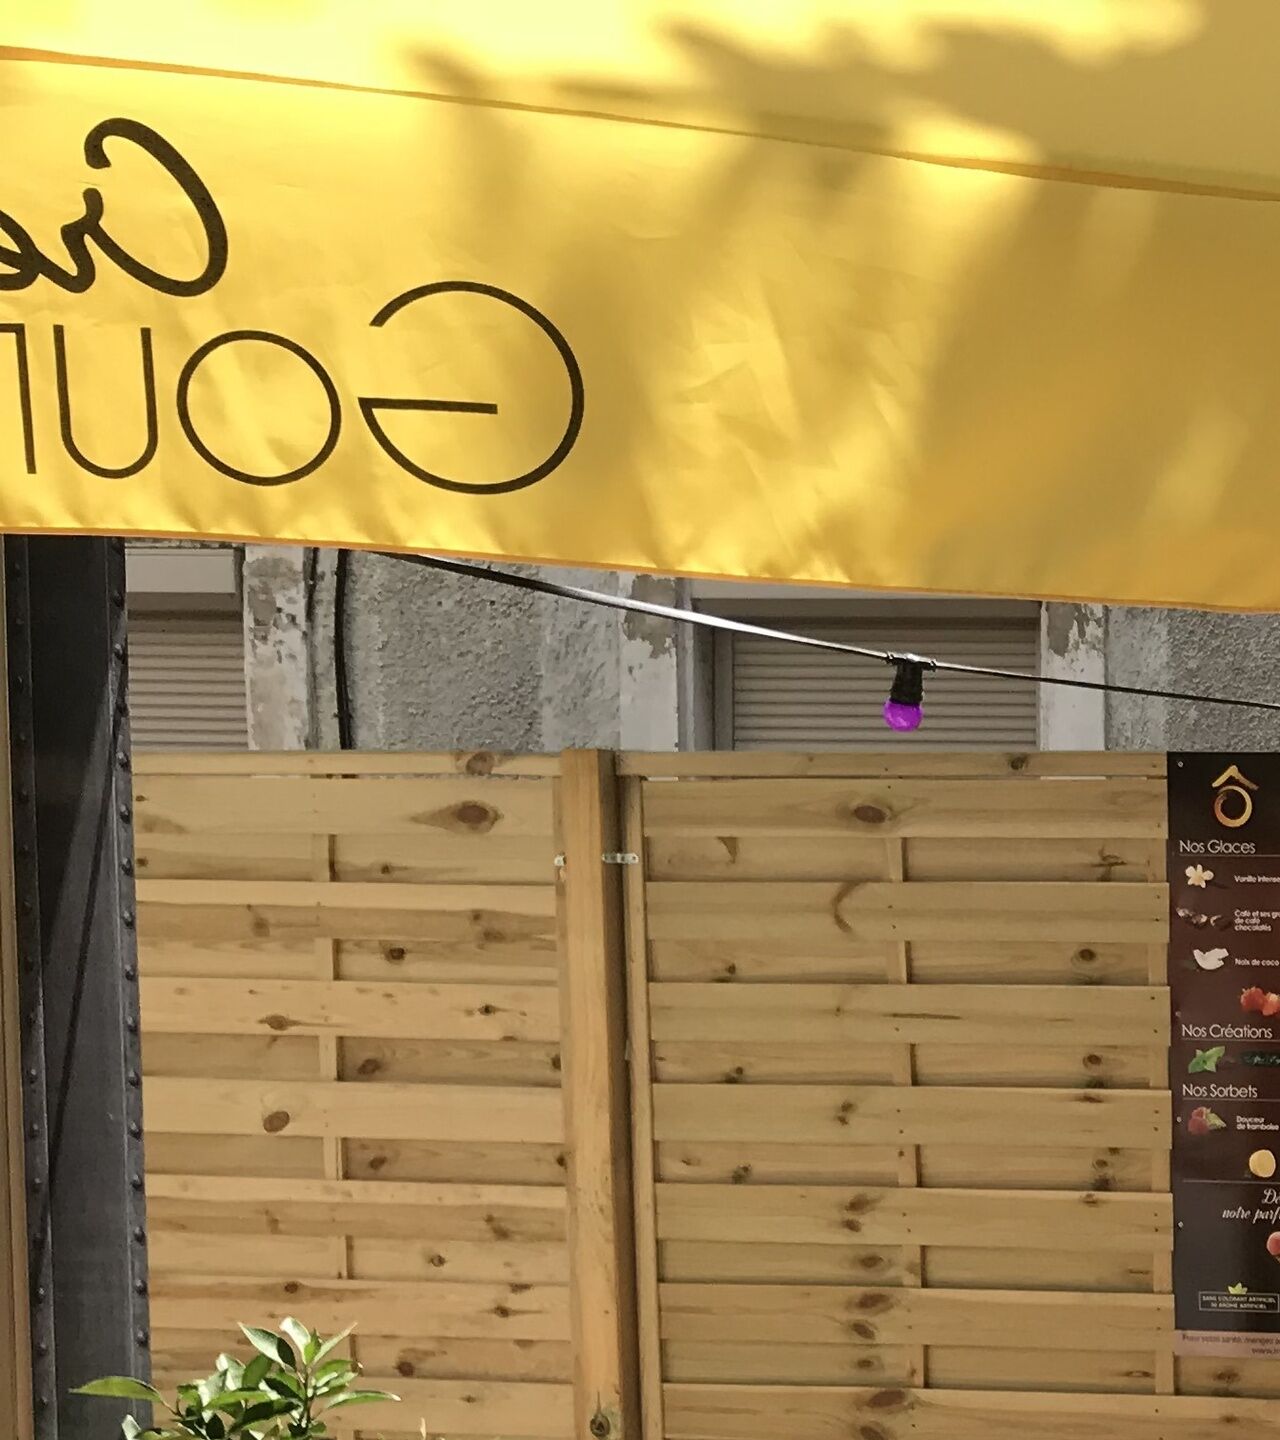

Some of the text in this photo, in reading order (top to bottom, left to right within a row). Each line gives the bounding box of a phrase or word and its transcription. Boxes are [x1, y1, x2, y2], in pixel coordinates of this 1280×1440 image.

[1179, 839, 1256, 854] Nos Glaces
[1251, 958, 1261, 966] de
[1181, 1023, 1273, 1039] Nos Créations
[1182, 1083, 1258, 1098] Nos Sorbets
[1222, 1206, 1251, 1219] notre
